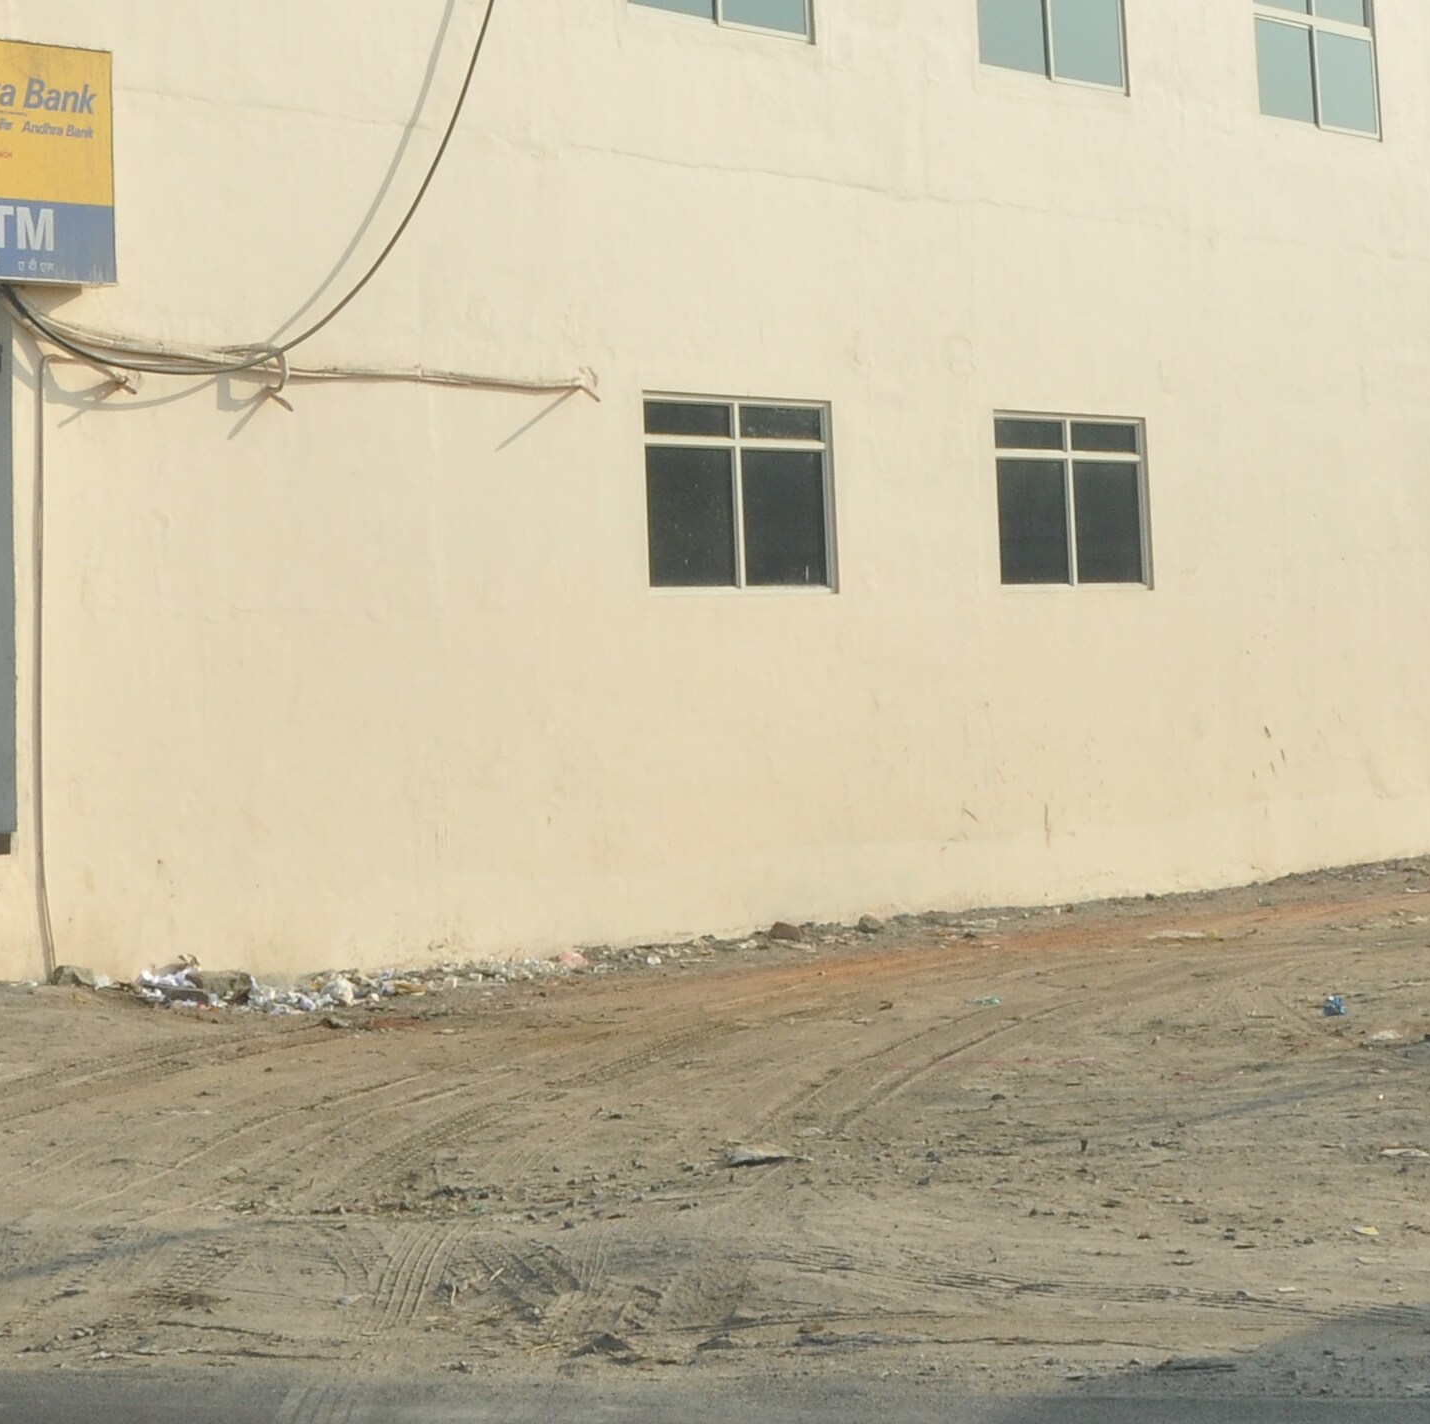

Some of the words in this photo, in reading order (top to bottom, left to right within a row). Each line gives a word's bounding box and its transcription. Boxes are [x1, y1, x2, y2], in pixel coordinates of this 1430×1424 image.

[23, 77, 96, 115] Bank
[22, 119, 63, 136] Andhra
[66, 124, 94, 139] Bank
